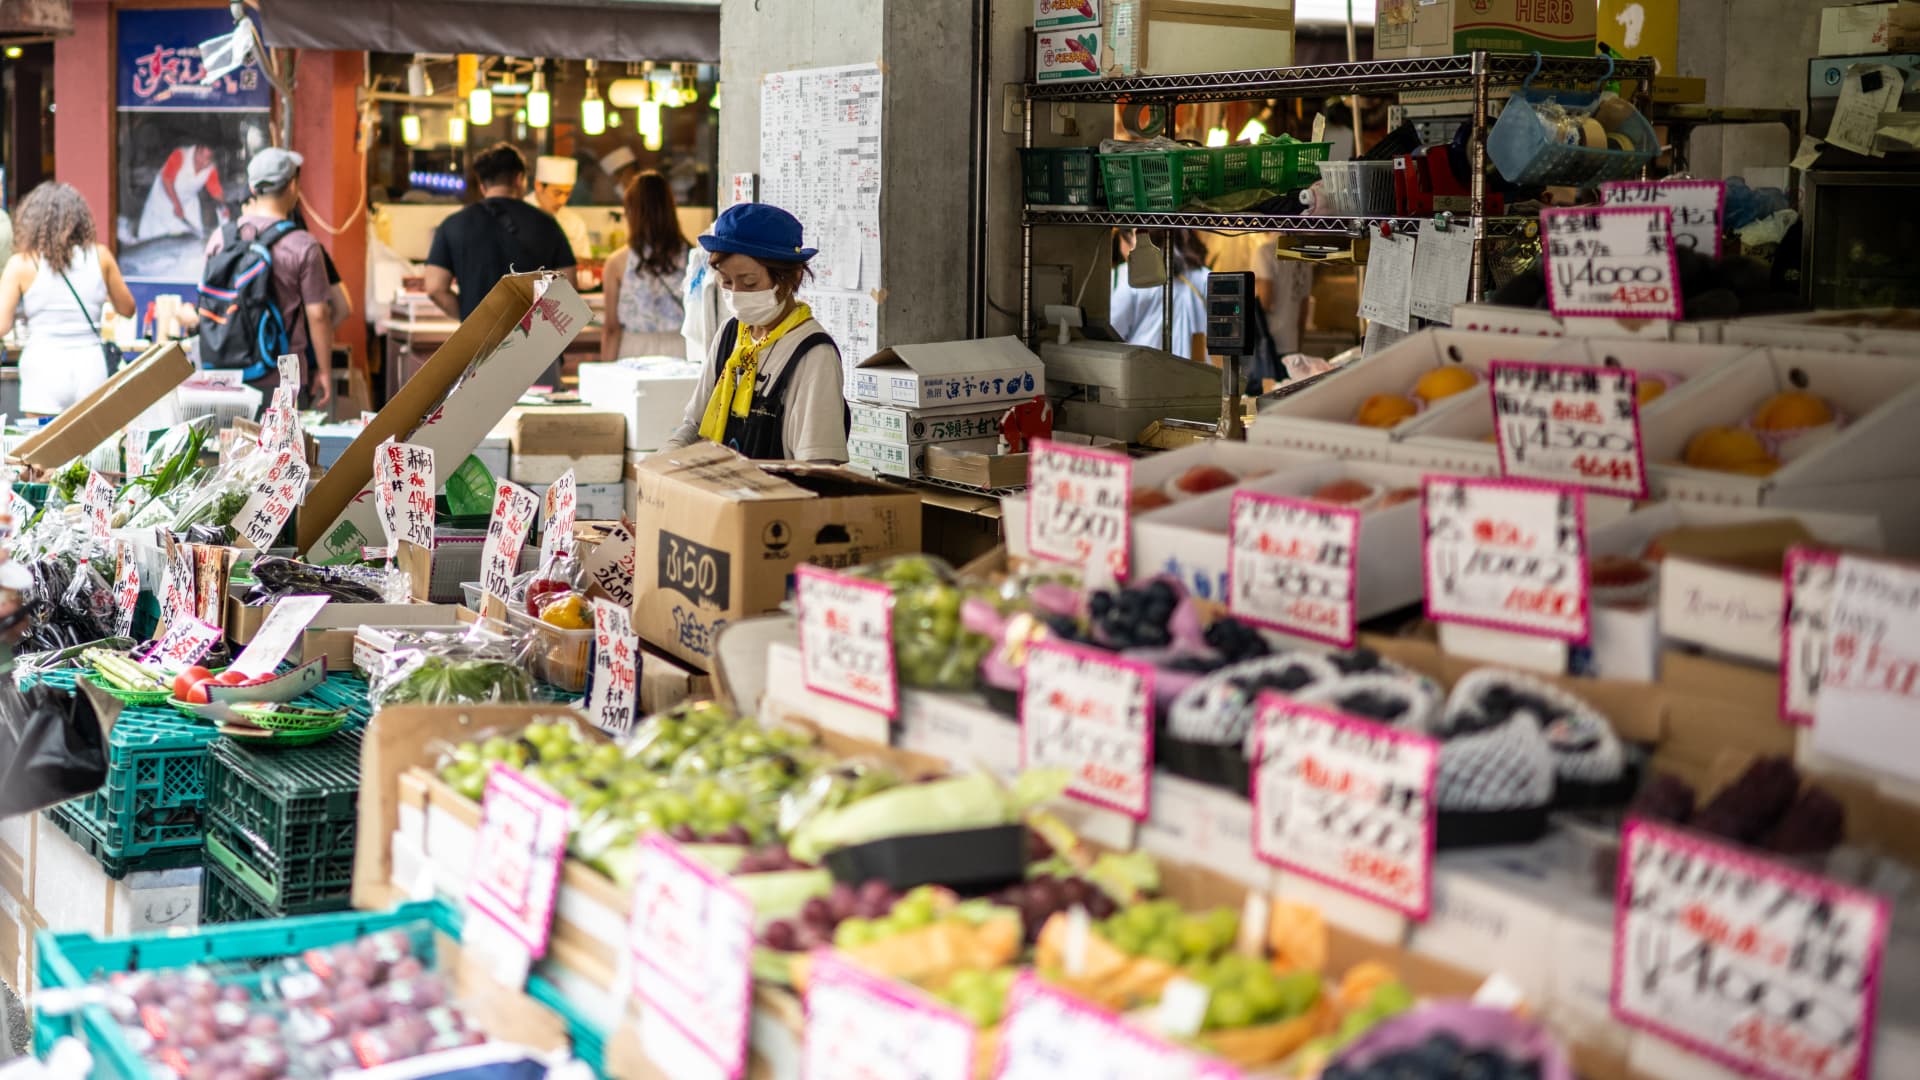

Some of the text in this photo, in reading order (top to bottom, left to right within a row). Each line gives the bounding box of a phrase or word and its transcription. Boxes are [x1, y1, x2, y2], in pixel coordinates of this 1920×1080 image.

[1515, 0, 1575, 24] HERB
[1557, 258, 1662, 298] ¥4000
[388, 446, 404, 477] 熊本
[666, 538, 718, 596] ふらの
[602, 705, 629, 731] 550円
